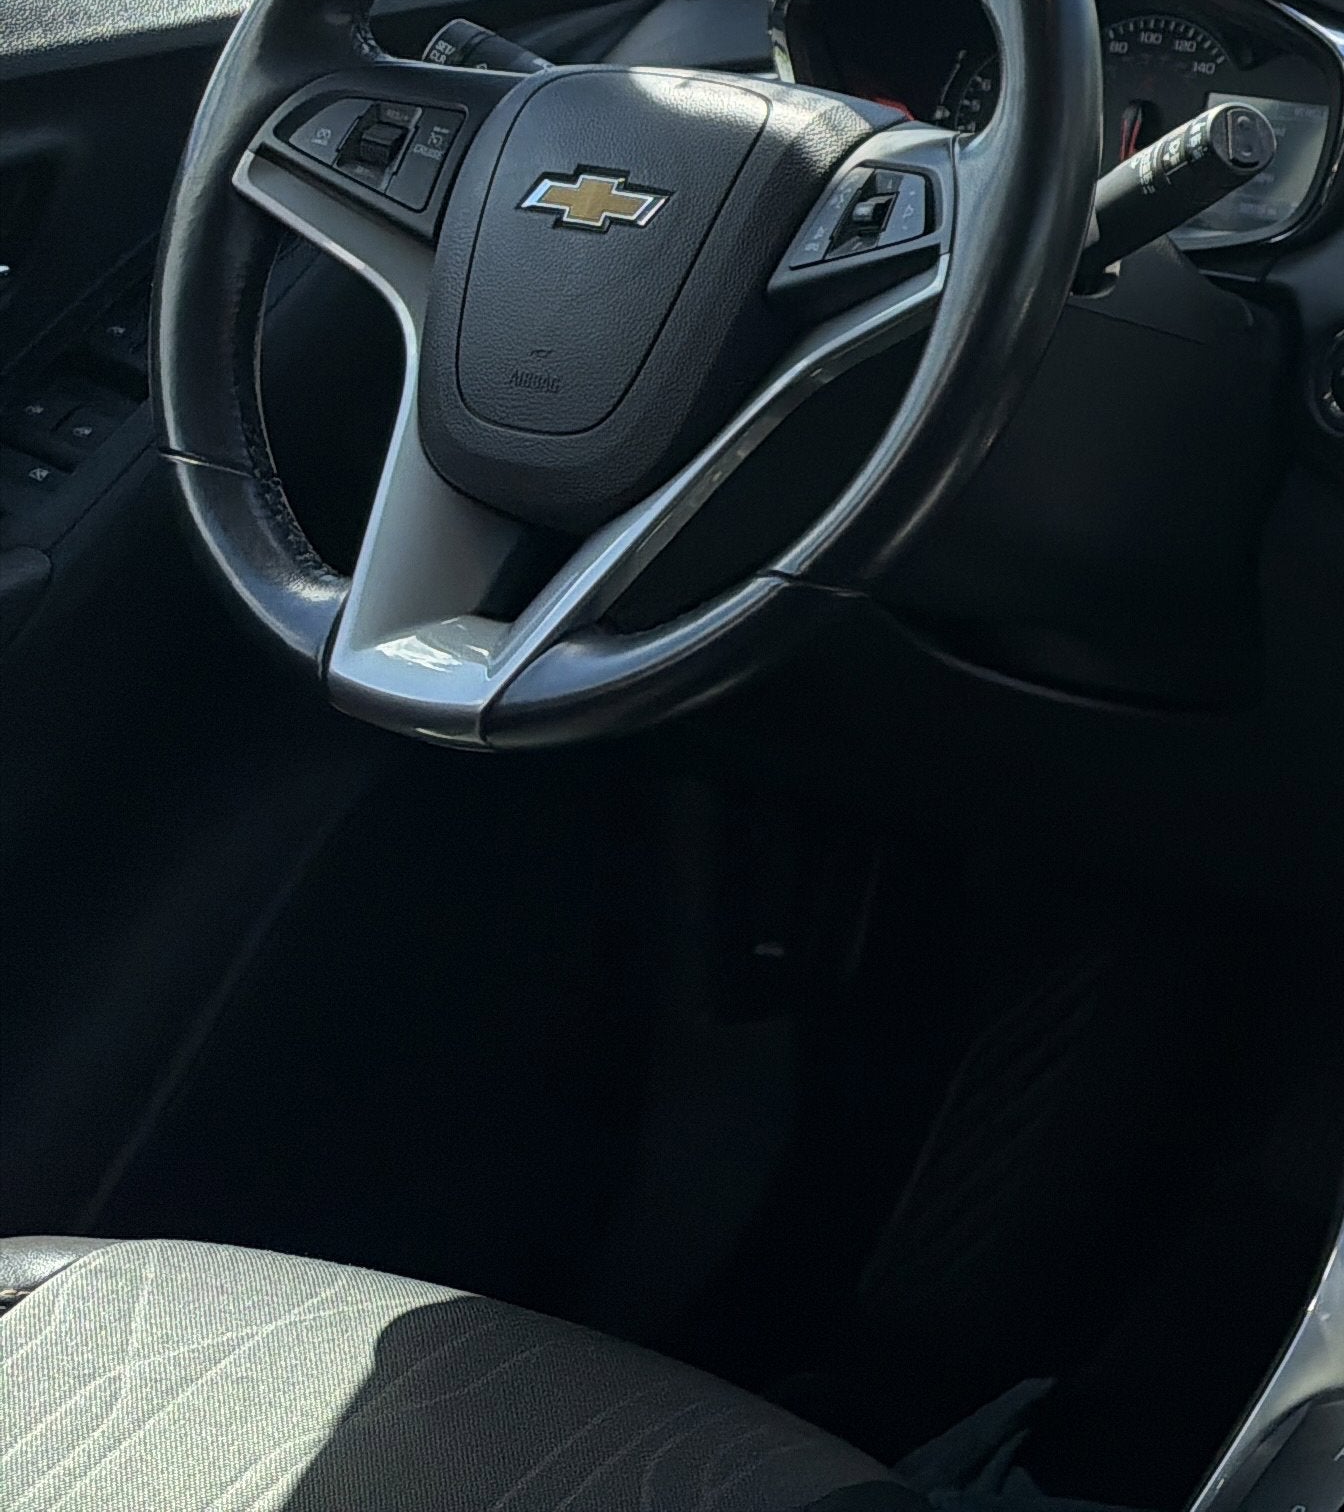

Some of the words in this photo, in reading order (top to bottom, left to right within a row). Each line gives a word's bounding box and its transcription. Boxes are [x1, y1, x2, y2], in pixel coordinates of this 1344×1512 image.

[1140, 32, 1162, 44] 100
[1109, 42, 1128, 54] 80
[1174, 40, 1196, 52] 120
[1193, 62, 1216, 75] 140
